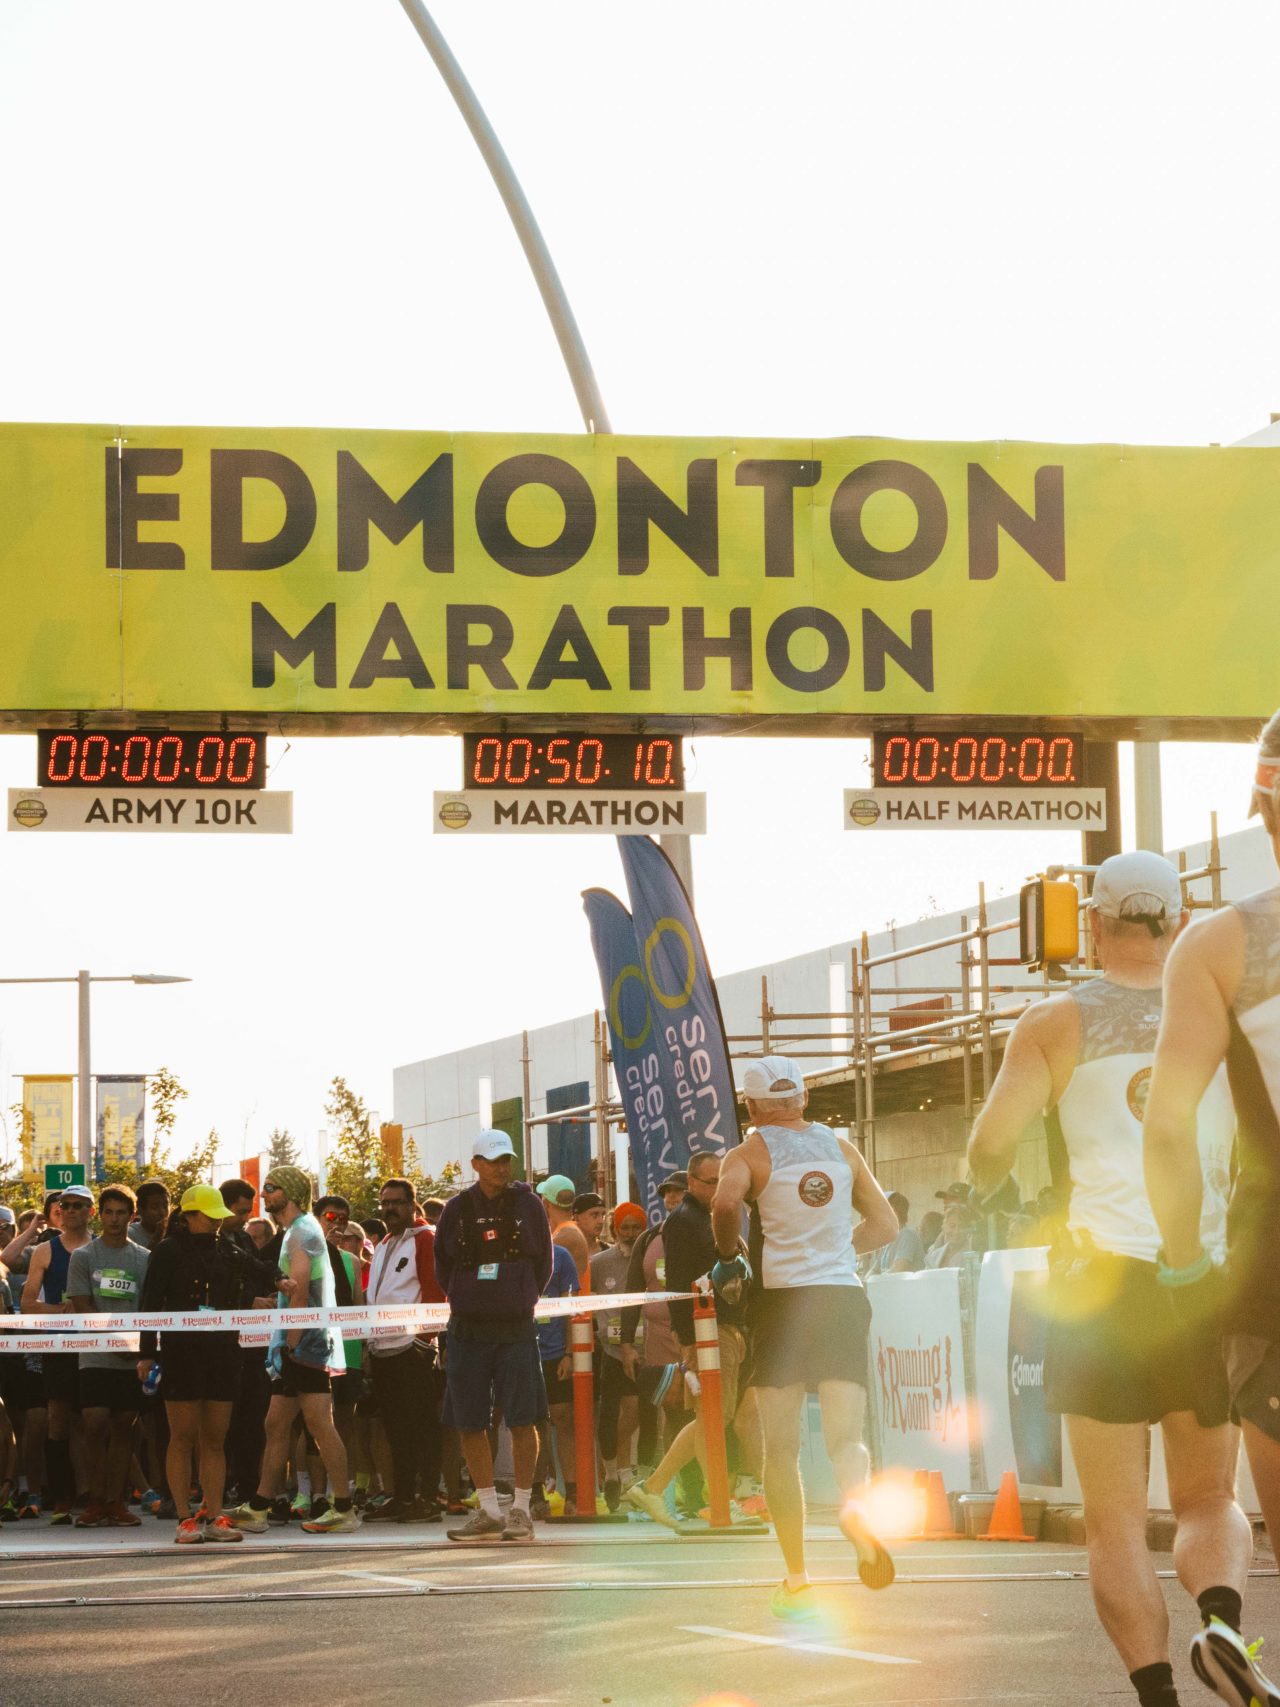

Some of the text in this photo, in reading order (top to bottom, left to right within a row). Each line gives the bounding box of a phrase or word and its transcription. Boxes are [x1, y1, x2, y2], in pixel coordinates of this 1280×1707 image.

[105, 447, 1066, 582] EDMONTON
[251, 600, 935, 693] MARATHON
[85, 797, 258, 825] ARMY 10K
[493, 800, 684, 827] MARATHON
[884, 800, 1102, 822] HALF MARATHON
[665, 1025, 697, 1125] credit
[109, 1279, 131, 1290] 3017
[886, 1333, 942, 1414] Running
